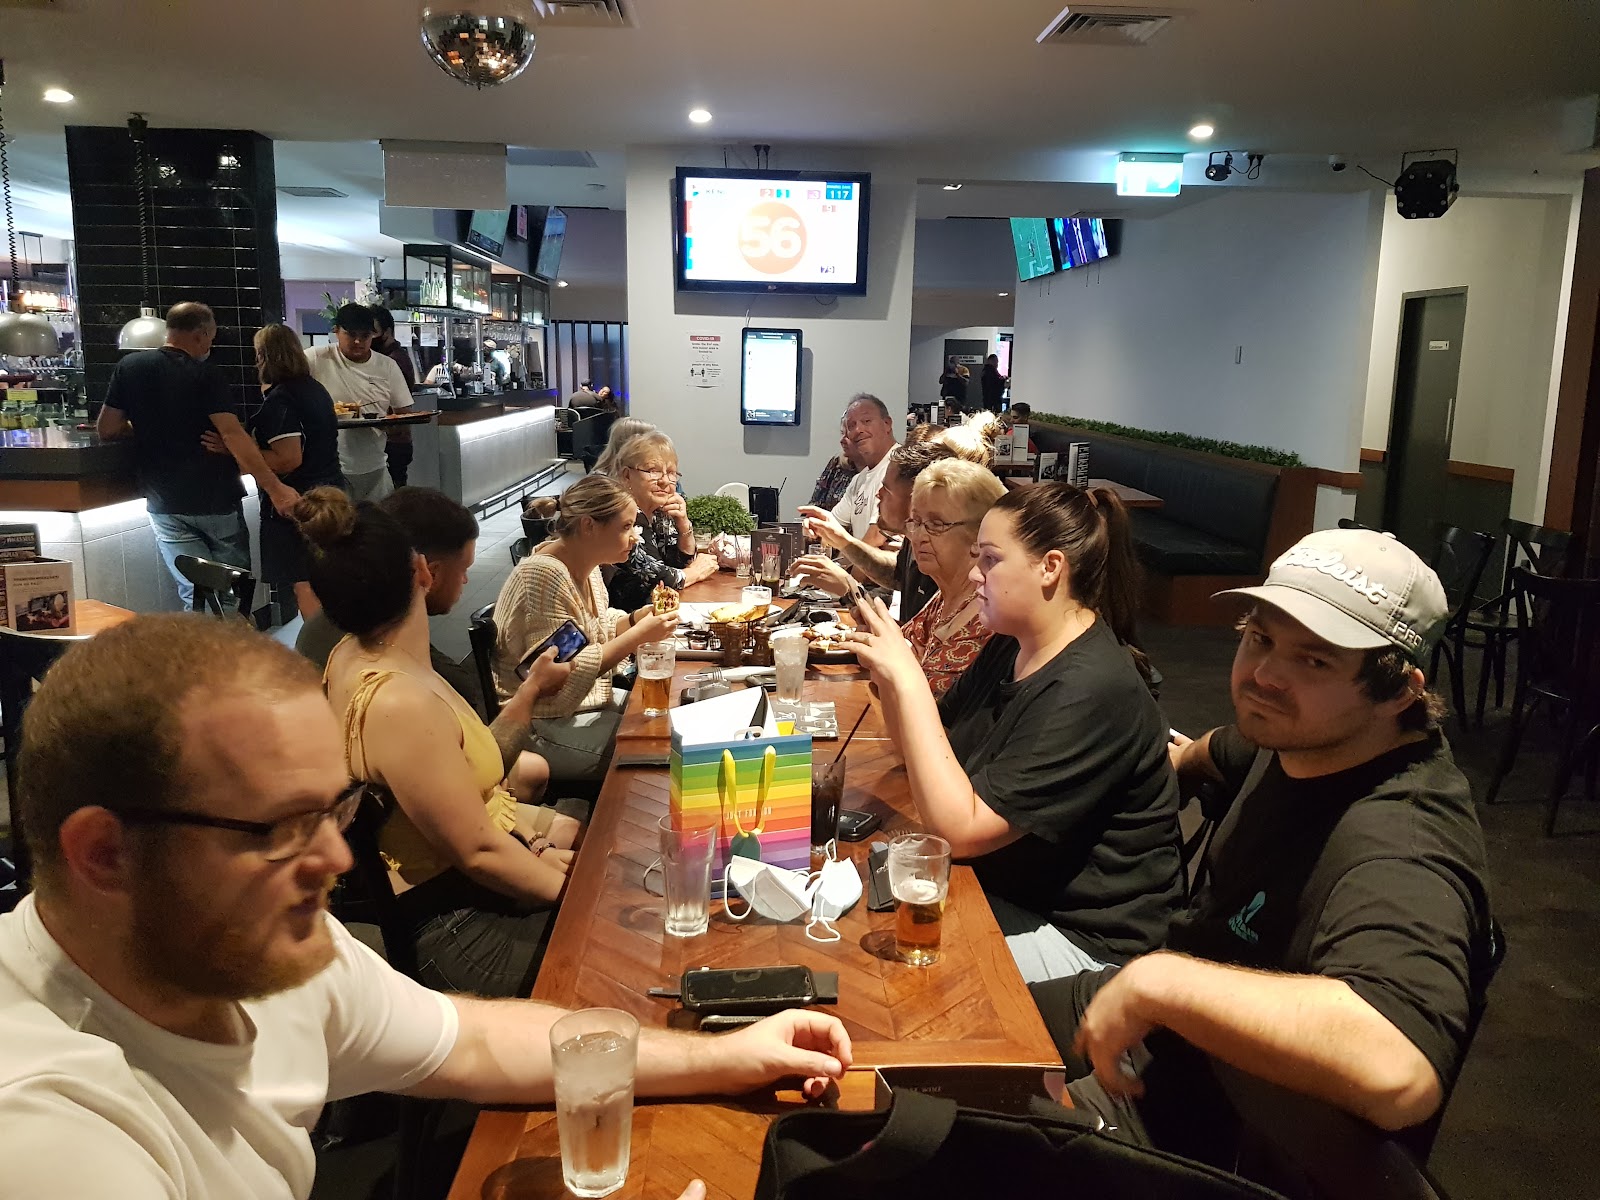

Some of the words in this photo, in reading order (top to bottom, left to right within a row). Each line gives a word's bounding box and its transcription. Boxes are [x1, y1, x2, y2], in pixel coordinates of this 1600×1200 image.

[830, 190, 850, 199] 117
[741, 216, 801, 258] 56
[725, 810, 741, 820] JUT
